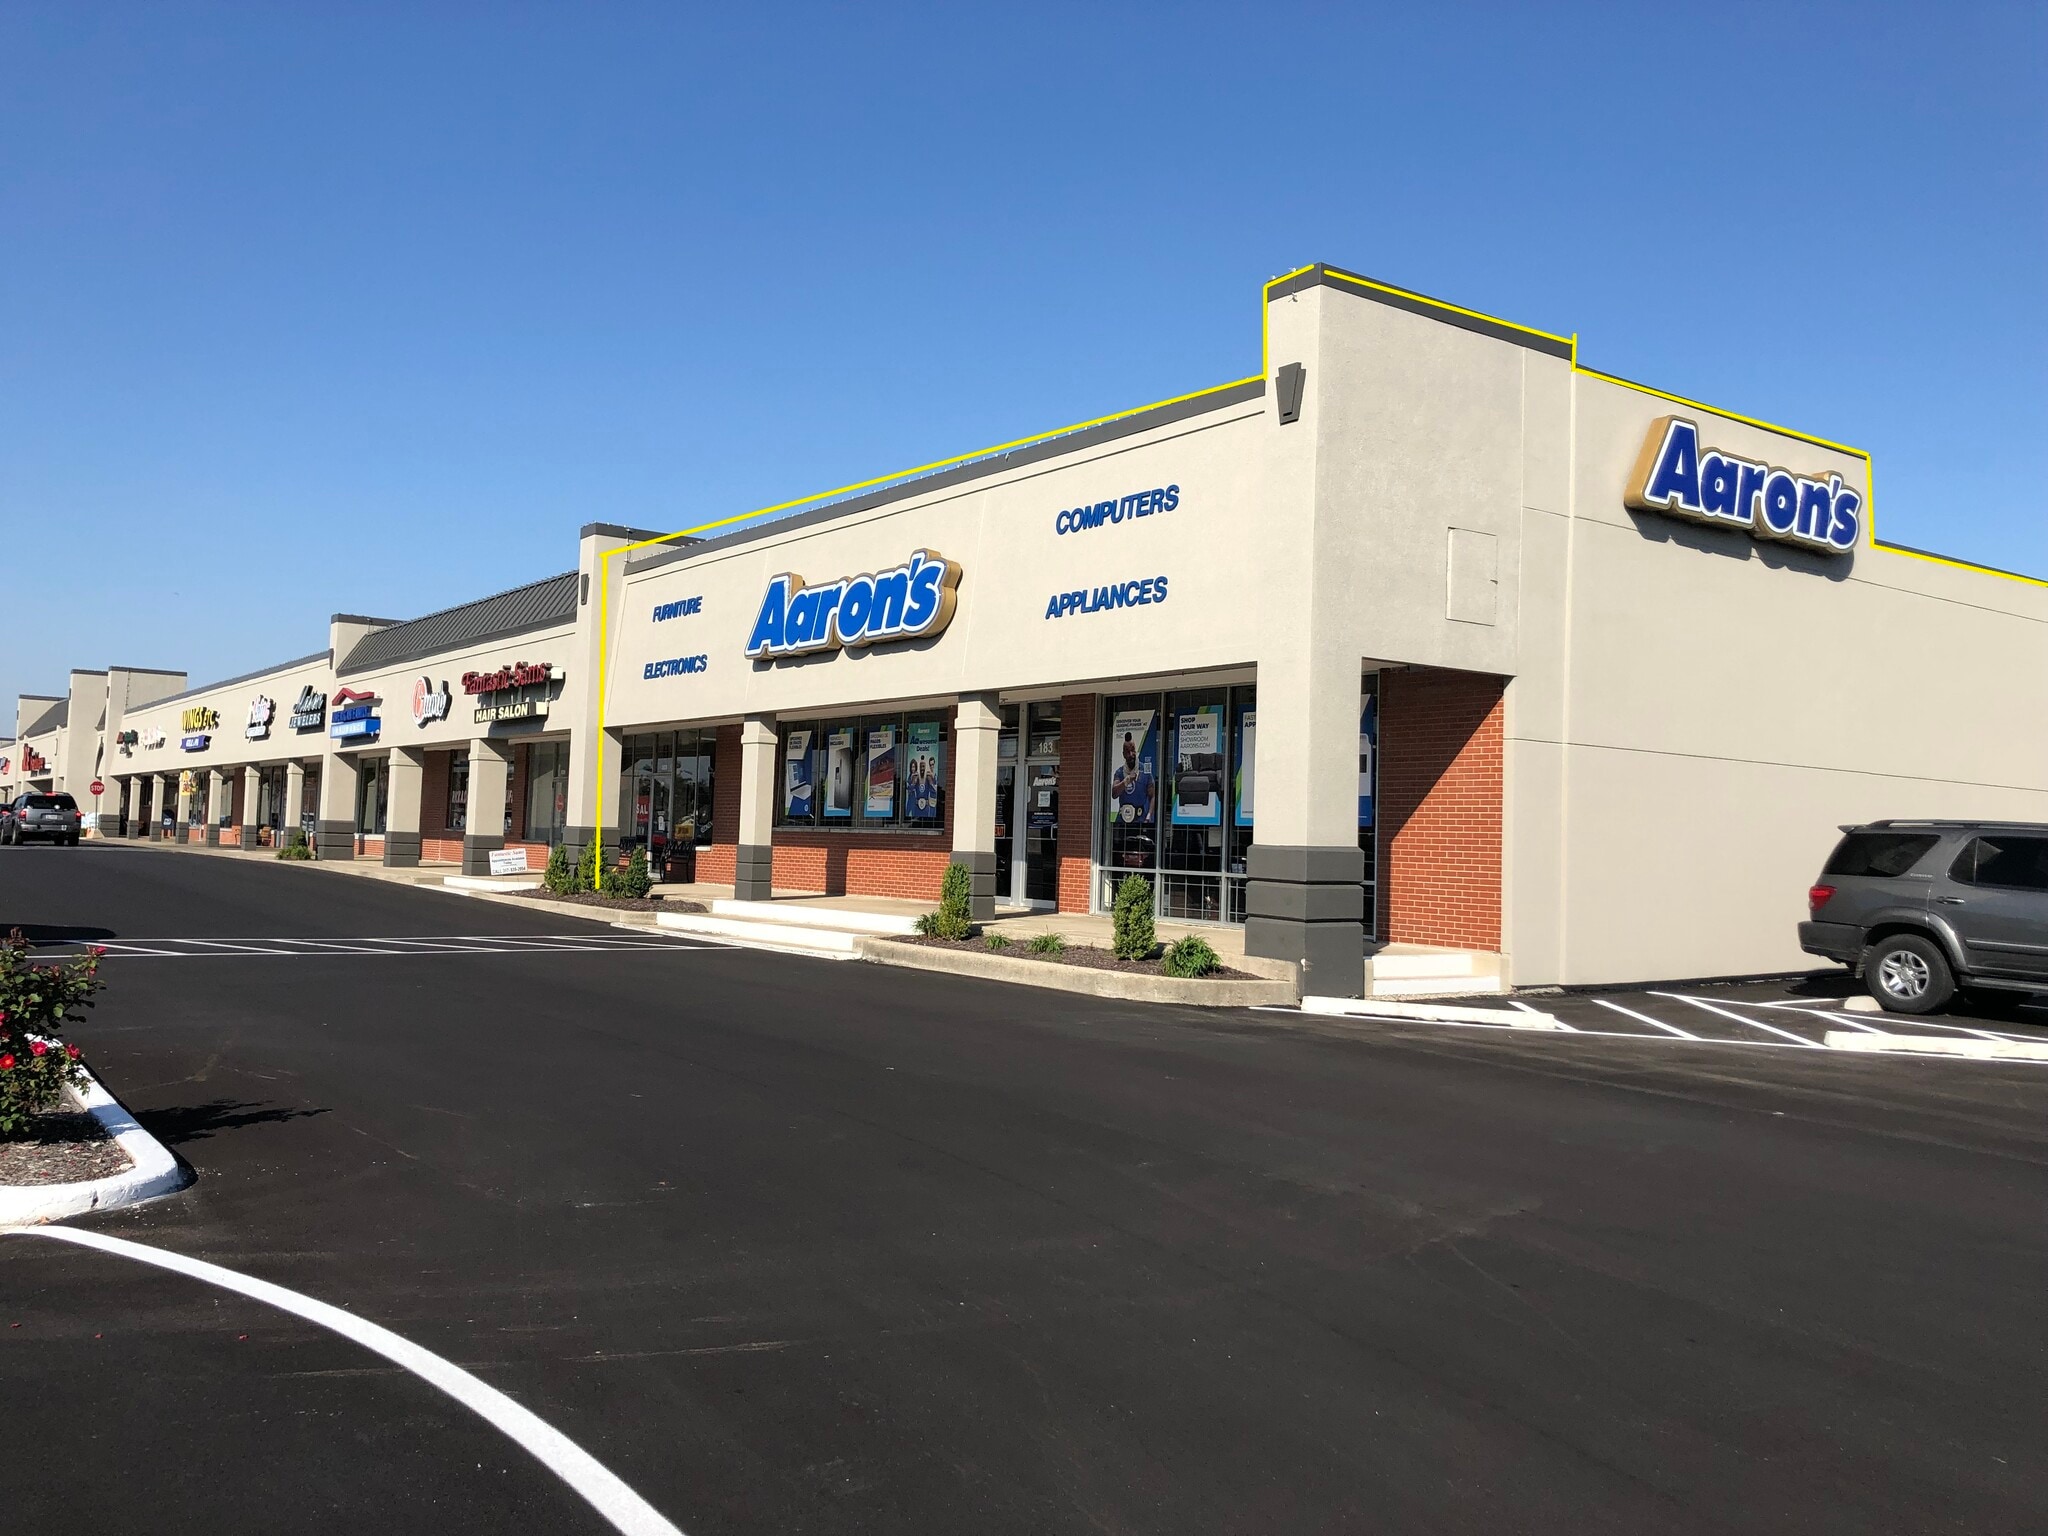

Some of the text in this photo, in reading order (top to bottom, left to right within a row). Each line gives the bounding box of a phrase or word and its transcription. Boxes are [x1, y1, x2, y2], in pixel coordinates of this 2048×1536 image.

[1645, 420, 1860, 549] Aaron's
[1056, 484, 1180, 535] COMPUTERS
[652, 596, 703, 623] FURNITURE
[744, 551, 946, 656] Aaron's
[1045, 576, 1168, 620] APPLIANCES
[461, 661, 546, 695] Fantastic Sams
[643, 654, 708, 680] ELECTRONICS
[289, 713, 321, 728] JEWELERS
[475, 703, 529, 722] HAIR SALON
[1039, 742, 1053, 754] 183
[90, 784, 104, 792] STOP
